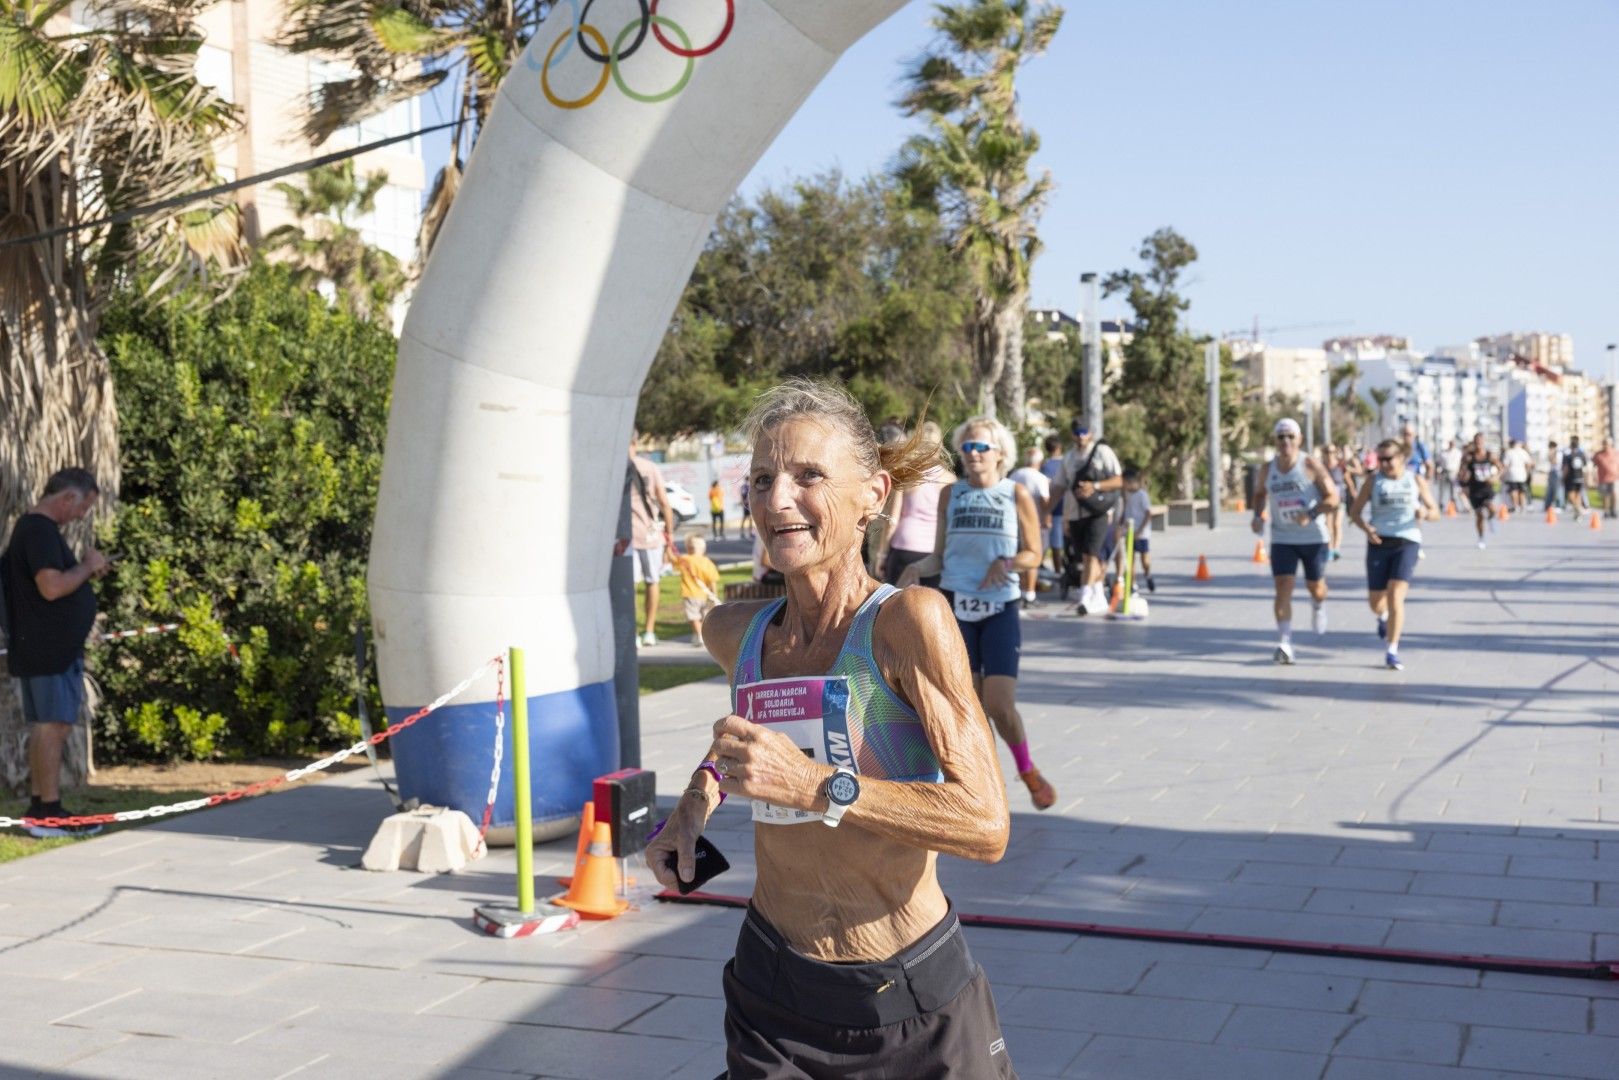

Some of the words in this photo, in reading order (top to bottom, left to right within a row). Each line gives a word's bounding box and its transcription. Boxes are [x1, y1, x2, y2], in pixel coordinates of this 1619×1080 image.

[959, 598, 990, 612] 121
[764, 698, 794, 709] SOLIDARIA
[768, 707, 806, 718] TORREVIEJA
[827, 731, 854, 771] KM
